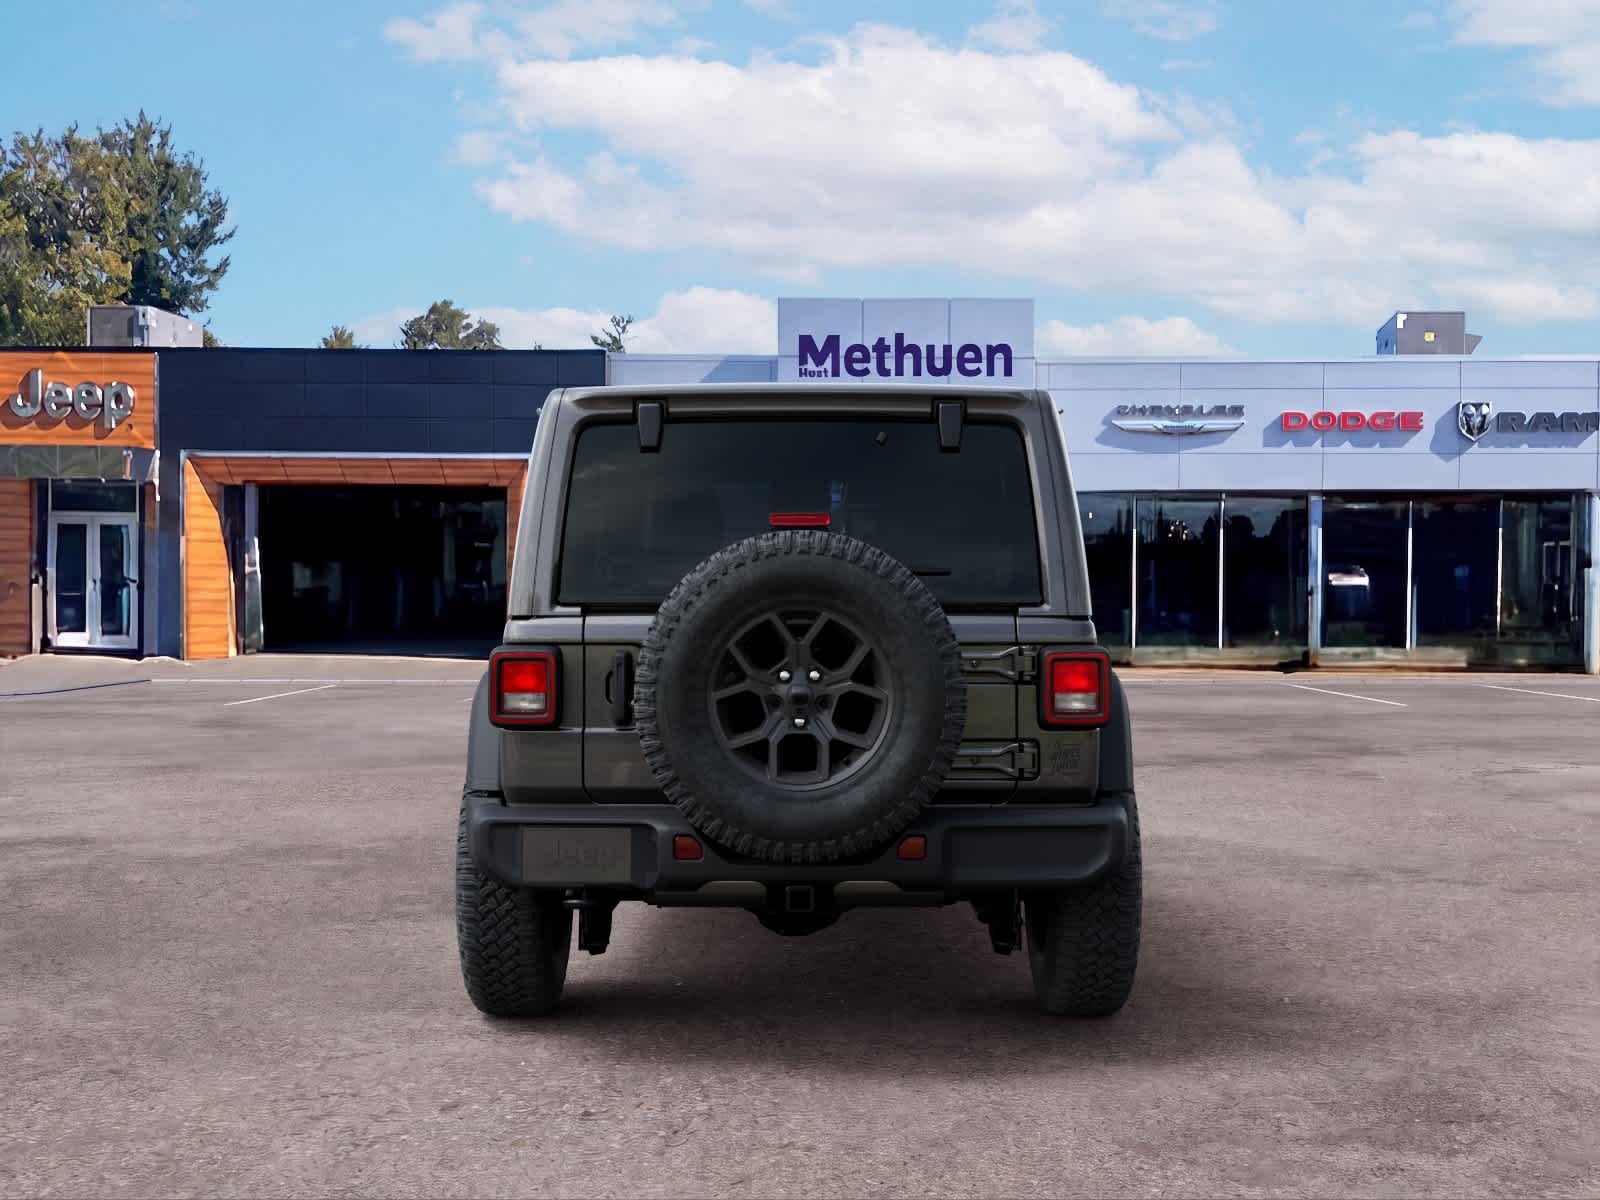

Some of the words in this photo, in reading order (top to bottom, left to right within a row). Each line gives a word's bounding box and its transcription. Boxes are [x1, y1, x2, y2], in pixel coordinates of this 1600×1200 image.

[799, 333, 1013, 378] Methuen
[9, 368, 135, 429] Jeep
[1282, 411, 1424, 432] DODGE
[1496, 411, 1600, 433] RAM
